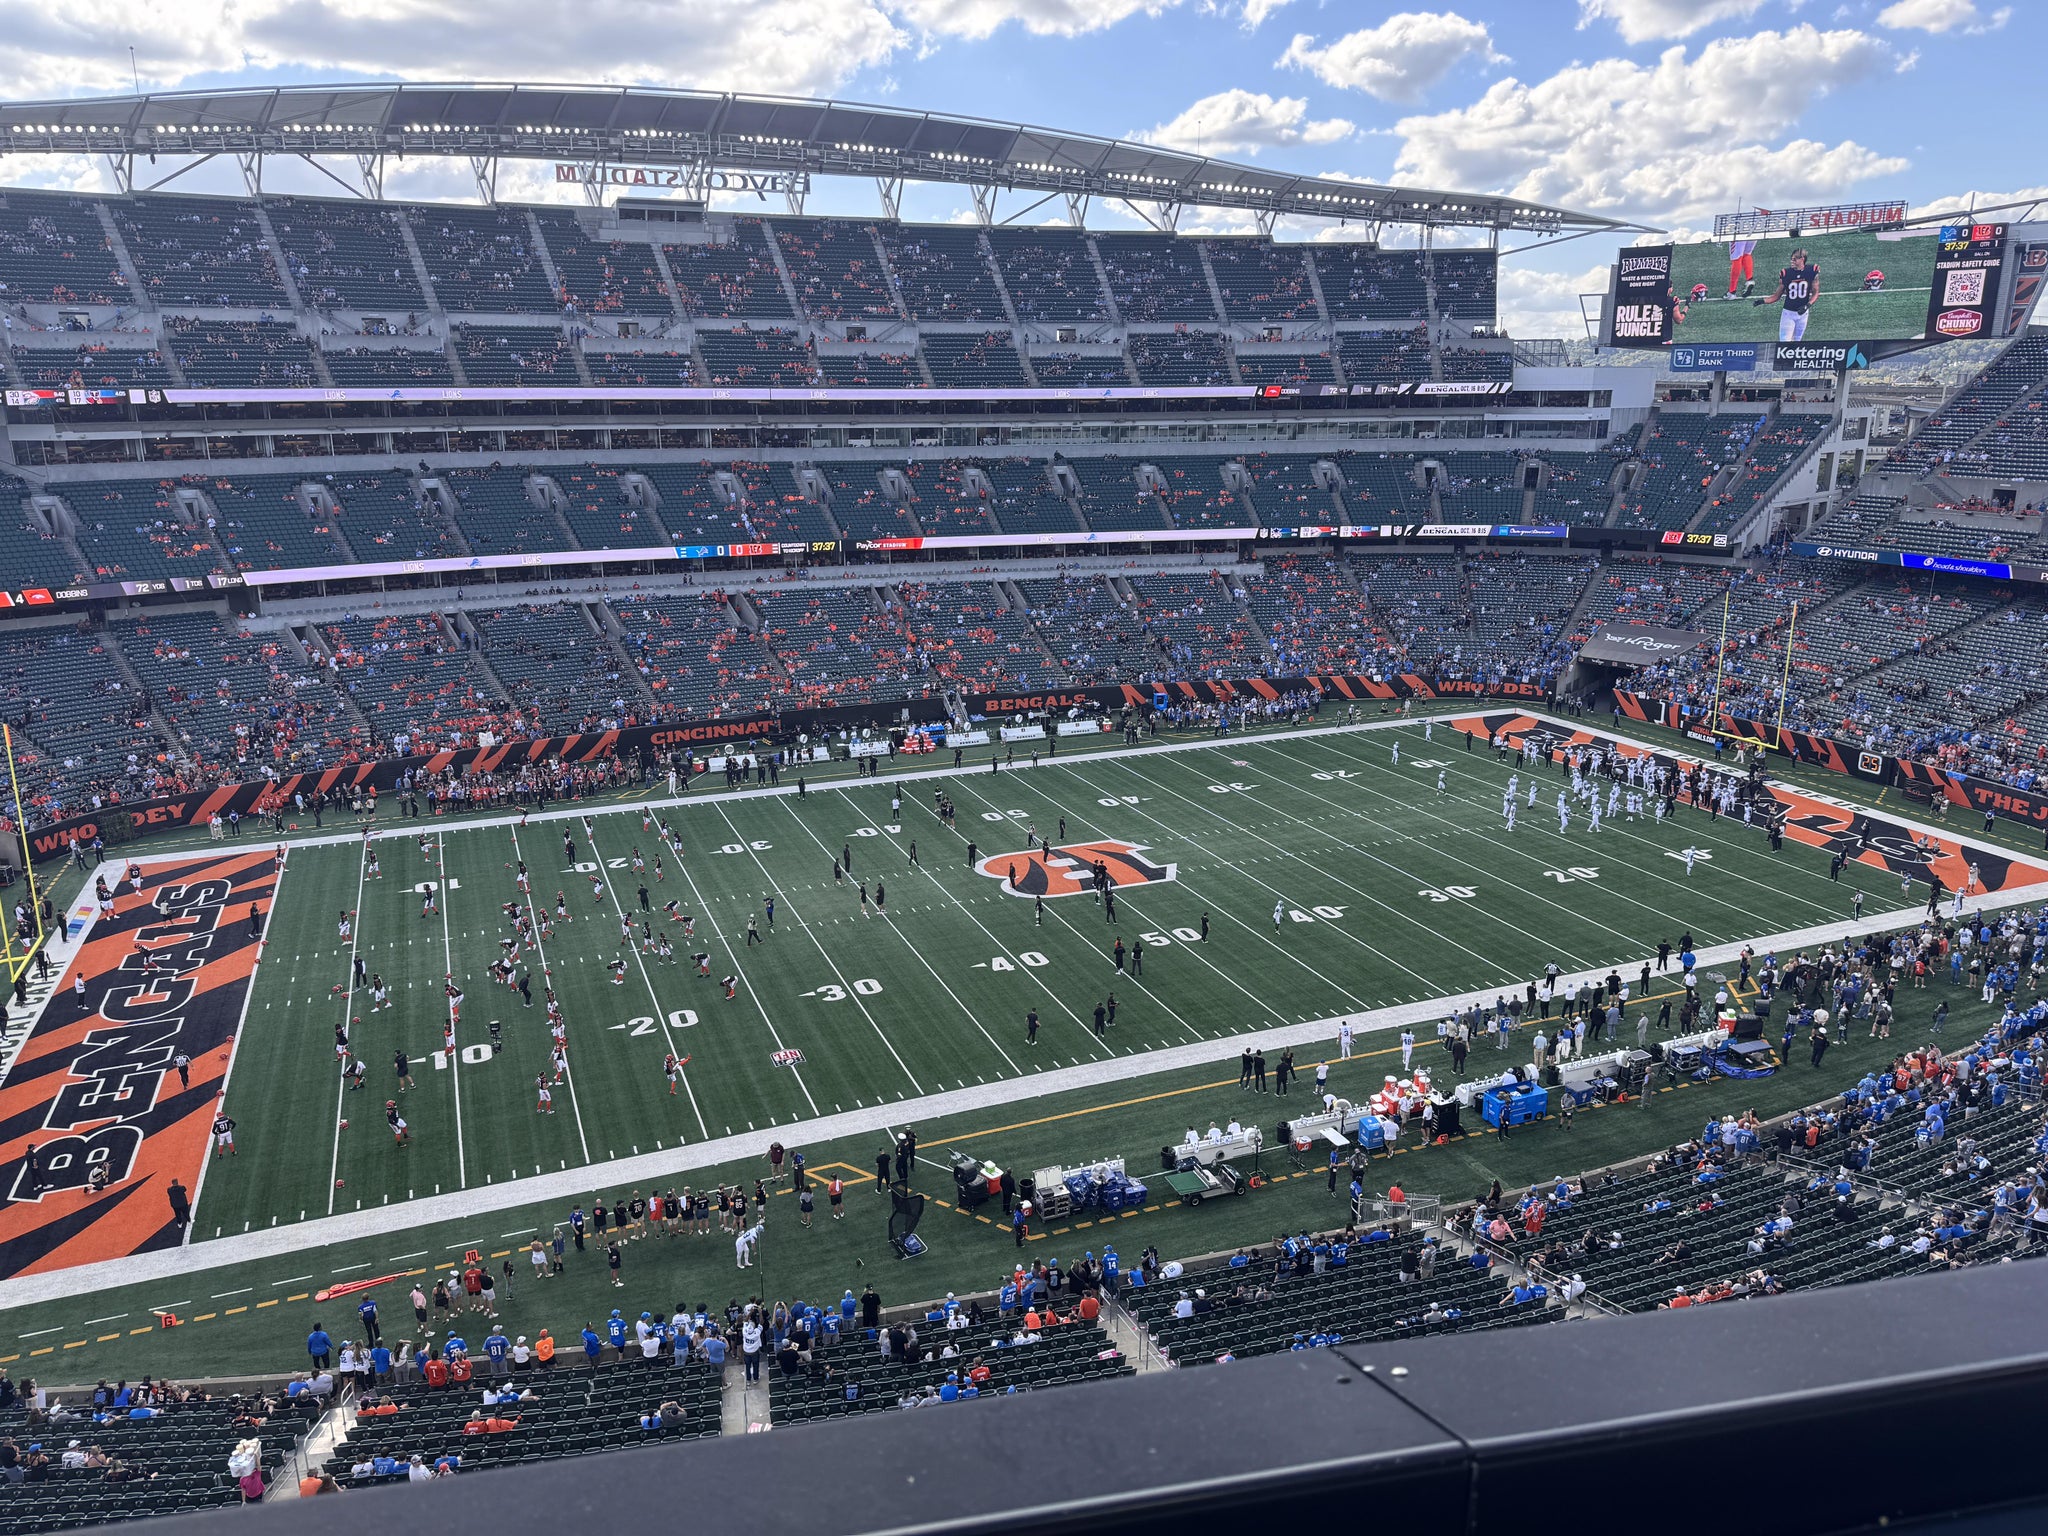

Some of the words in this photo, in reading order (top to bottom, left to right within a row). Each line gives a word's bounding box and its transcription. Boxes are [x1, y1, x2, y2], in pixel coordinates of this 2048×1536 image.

[1808, 206, 1902, 228] STADIUM
[1944, 241, 1970, 251] 37:37
[1936, 261, 1961, 269] STADIUM
[1961, 260, 1982, 268] SAFETY
[1983, 259, 2001, 267] GUIDE
[1788, 280, 1808, 300] 80
[1615, 303, 1652, 323] RULE
[1615, 321, 1662, 337] JUNGLE
[1938, 318, 1979, 329] CHUNKY
[1699, 350, 1724, 358] FIFTH
[1726, 349, 1754, 357] THIRD
[1776, 346, 1846, 361] Kettering
[1698, 358, 1723, 366] BANK
[1793, 359, 1834, 369] HEALTH
[811, 541, 836, 551] 37:37
[856, 539, 882, 550] Paycor
[1686, 534, 1712, 544] 37:37
[1833, 549, 1879, 561] HYUNDAI
[15, 593, 25, 604] 4
[135, 584, 149, 593] 72
[216, 577, 227, 586] 17
[1624, 637, 1681, 650] Kroger
[1438, 681, 1485, 692] WHO
[985, 693, 1086, 712] BENGALS
[1687, 730, 1716, 745] BENGALS.COM
[1861, 755, 1878, 772] 25
[1832, 801, 1868, 815] US
[1974, 787, 2030, 816] THE
[34, 823, 98, 853] WHO
[1543, 866, 1600, 884] 20
[1417, 884, 1477, 902] 30
[1288, 904, 1344, 924] 40
[1138, 926, 1202, 947] 50
[991, 950, 1051, 972] 40
[815, 977, 884, 1002] 30
[627, 1008, 700, 1038] 20
[7, 878, 232, 1204] BENGALS
[433, 1043, 494, 1071] 10
[218, 1121, 229, 1133] 91
[608, 1325, 620, 1337] 16
[491, 1345, 502, 1357] 81
